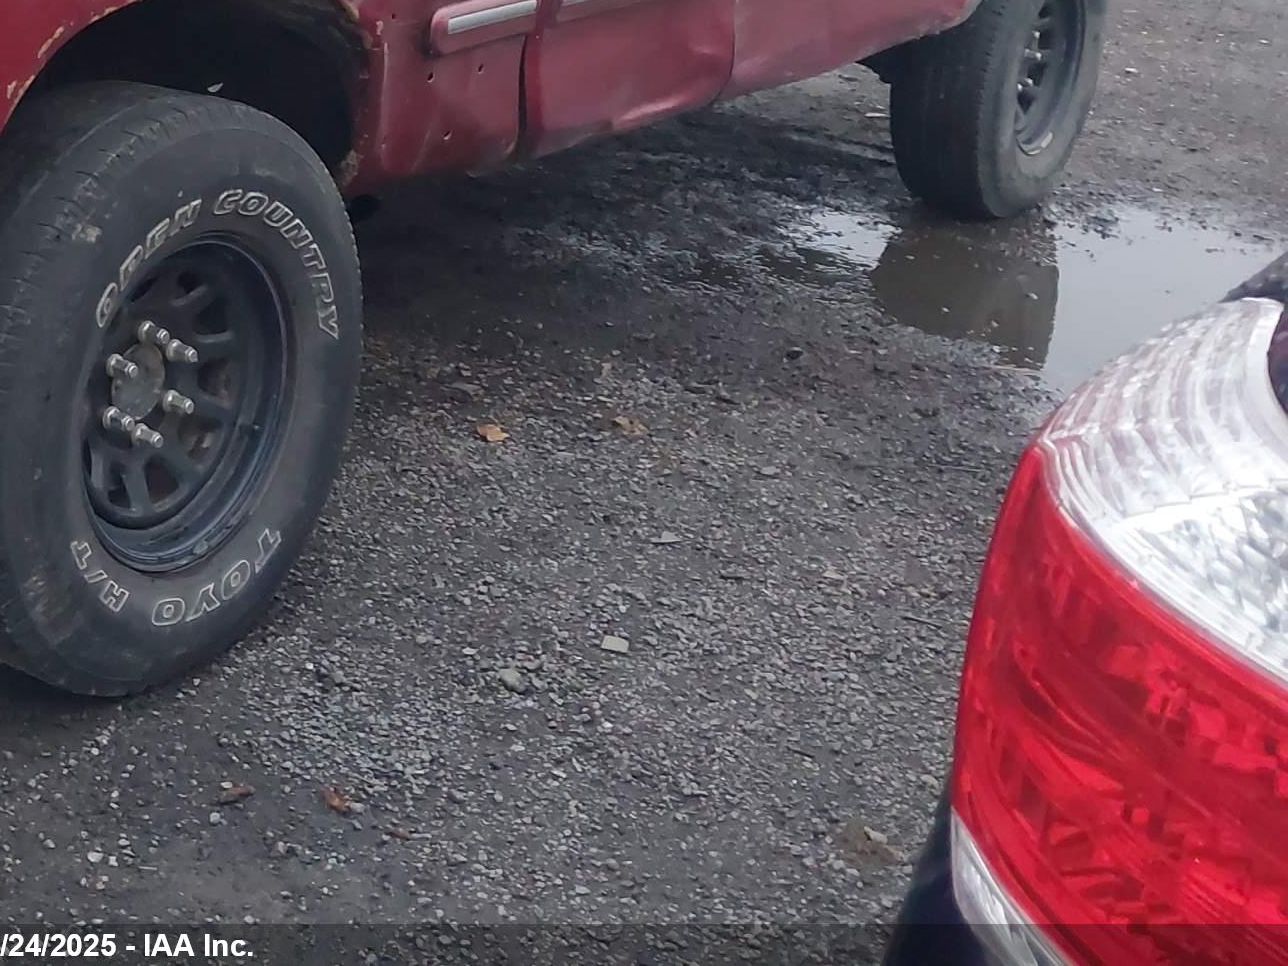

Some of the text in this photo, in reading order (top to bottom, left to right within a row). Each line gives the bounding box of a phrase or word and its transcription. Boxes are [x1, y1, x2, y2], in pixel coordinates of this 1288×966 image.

[95, 188, 340, 340] OPEN COUNTRY
[69, 528, 283, 627] TOYO H/T
